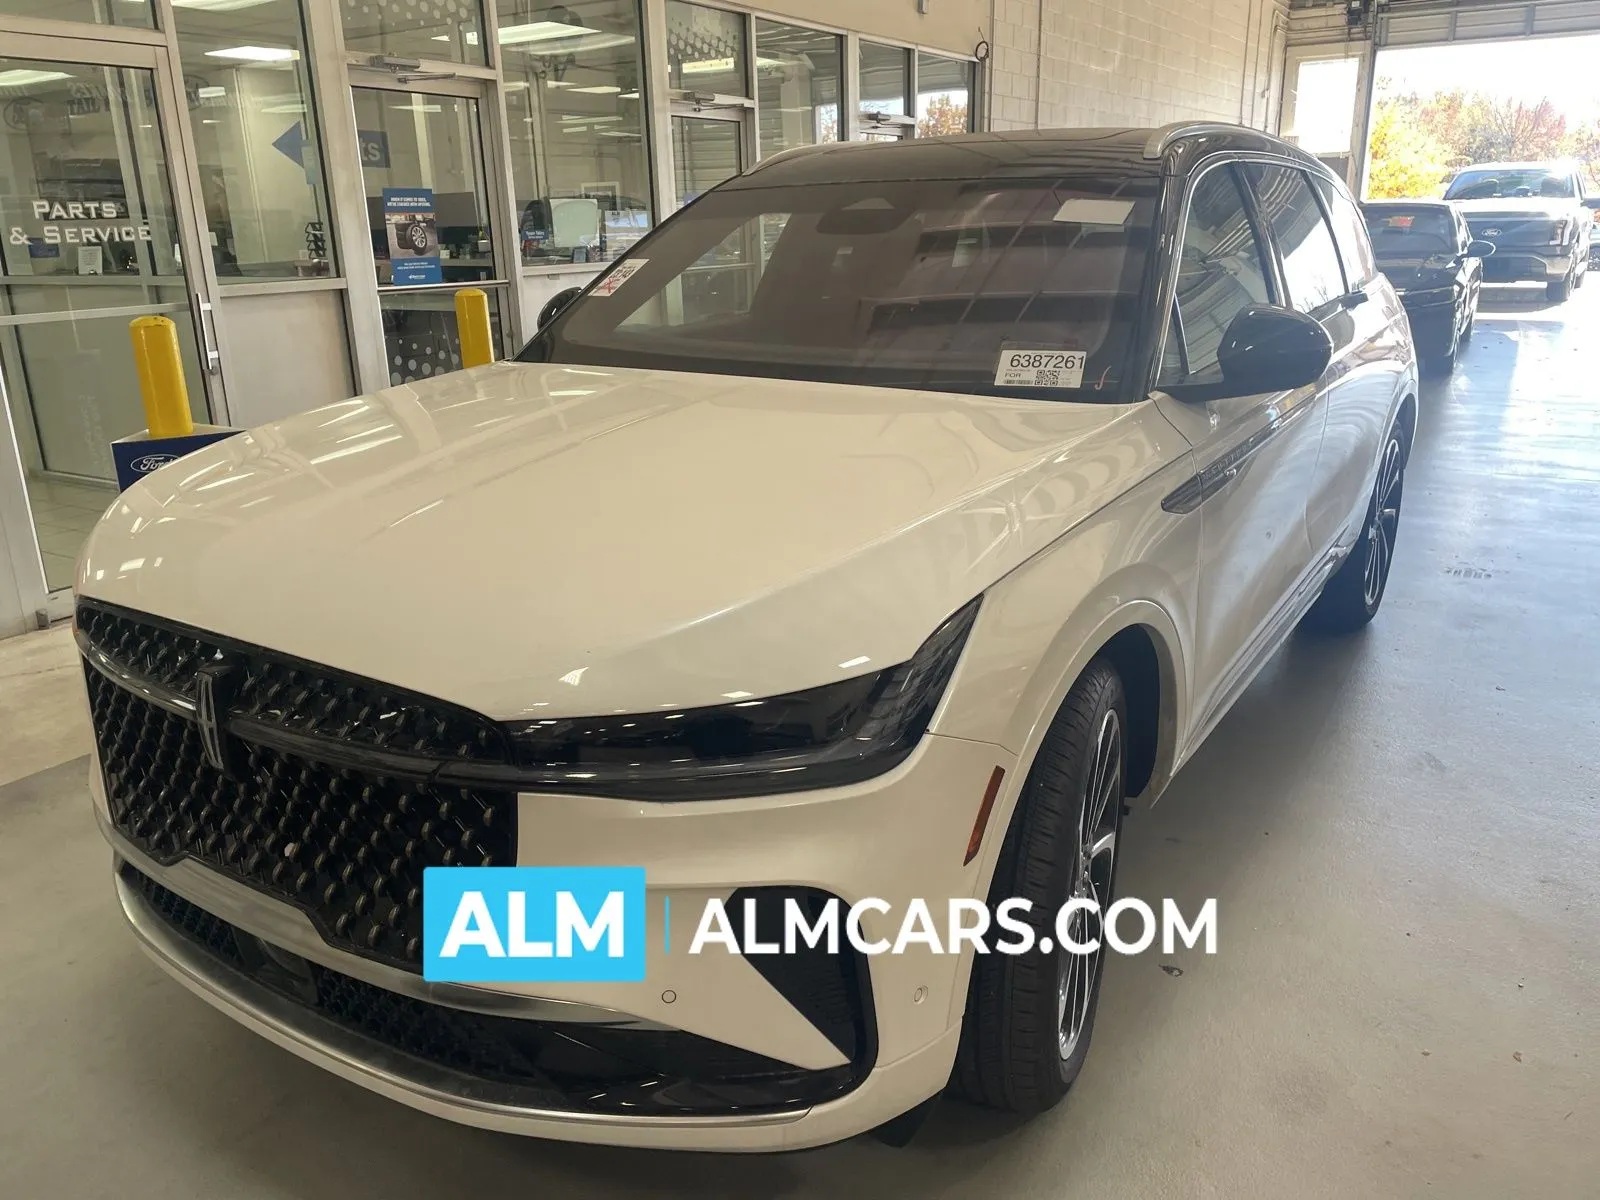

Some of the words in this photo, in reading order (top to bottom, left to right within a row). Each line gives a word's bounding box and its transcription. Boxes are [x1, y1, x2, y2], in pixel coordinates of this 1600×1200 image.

[32, 200, 118, 219] PARTS
[9, 227, 32, 245] &
[43, 225, 152, 243] SERVICE
[1010, 354, 1085, 369] 6387261
